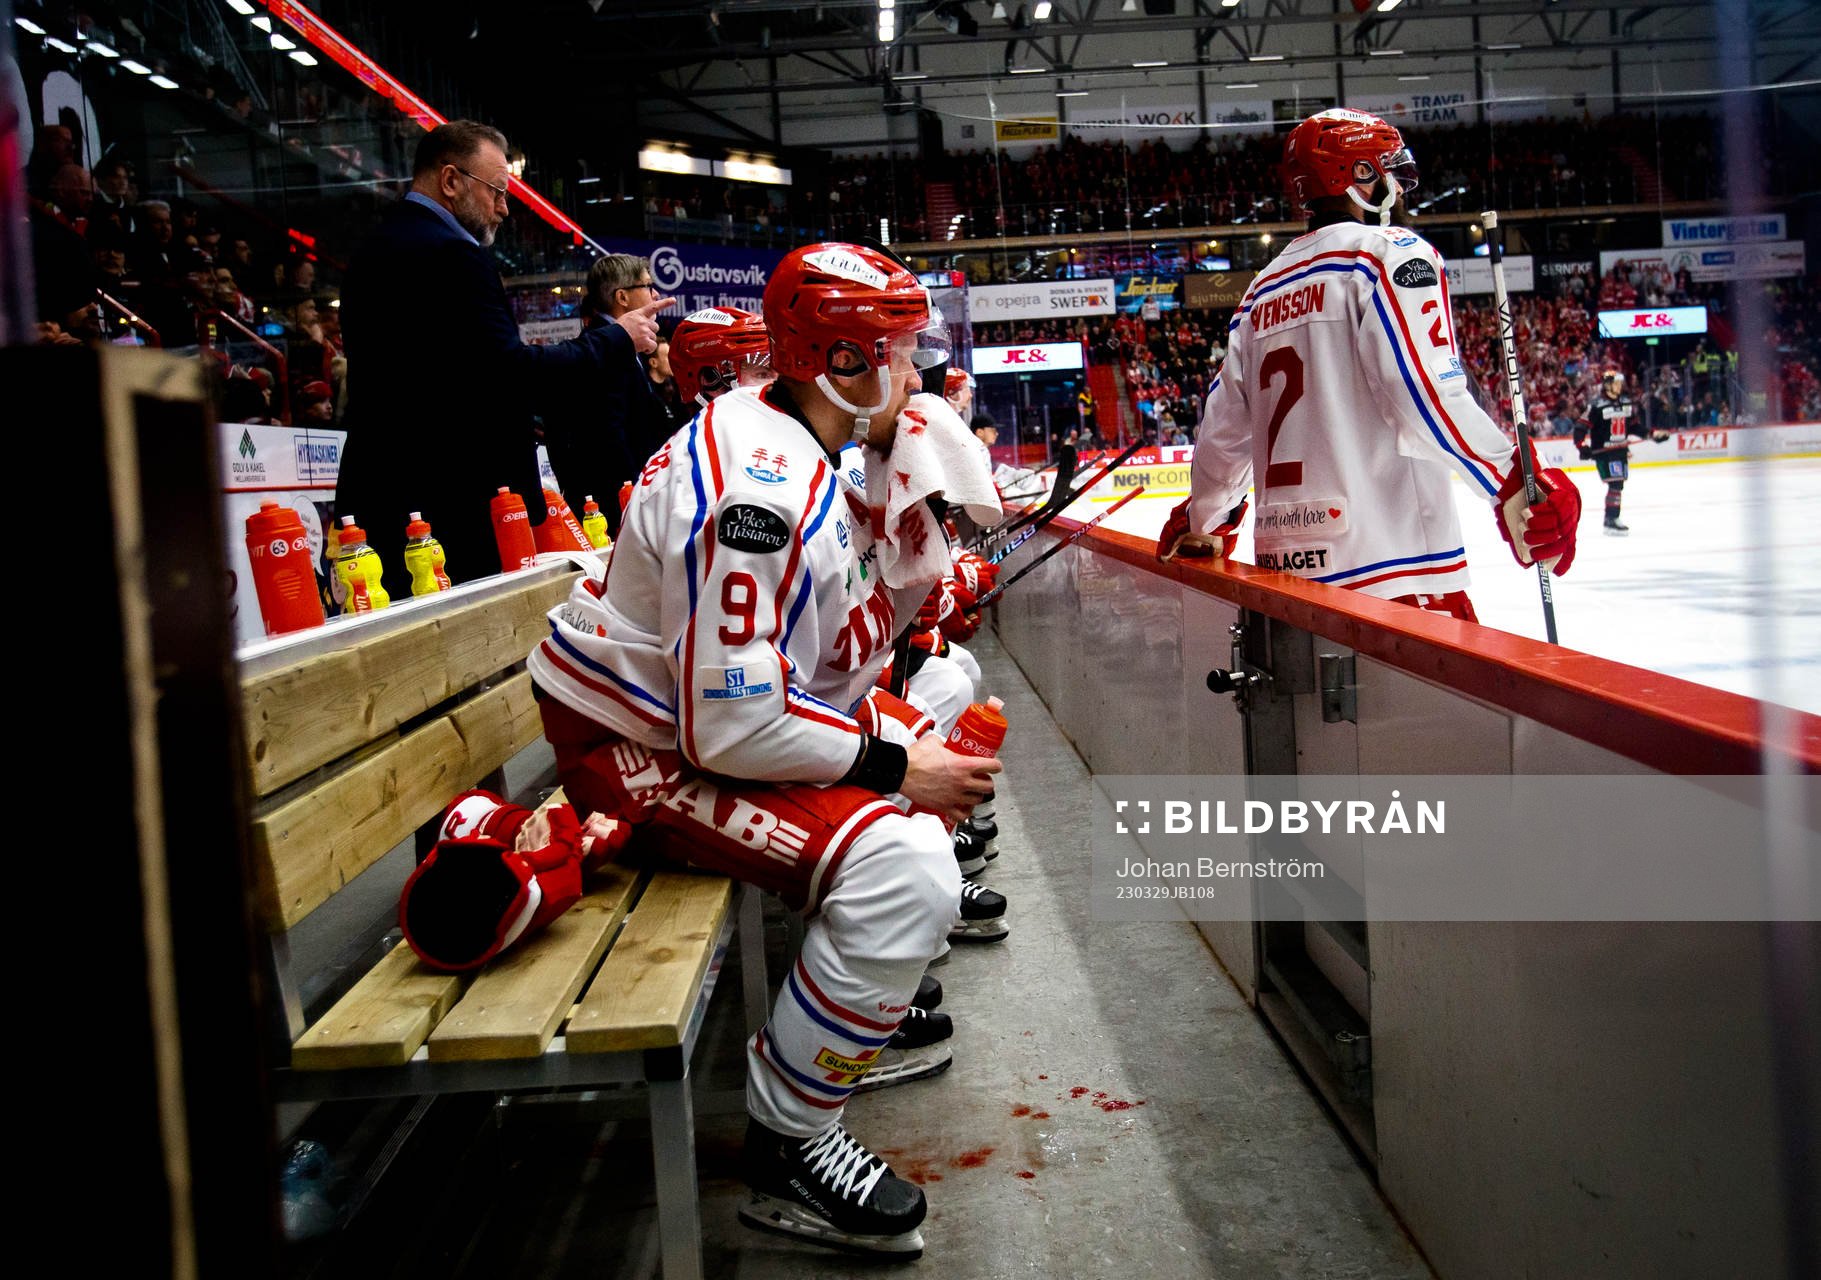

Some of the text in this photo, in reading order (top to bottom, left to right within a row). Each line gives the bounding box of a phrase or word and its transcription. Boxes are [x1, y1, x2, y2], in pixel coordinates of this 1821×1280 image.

[1411, 93, 1465, 109] TRAVEL
[1412, 108, 1458, 123] TEAM
[650, 246, 766, 291] Gustavsvik
[1421, 299, 1449, 348] 2
[1499, 301, 1522, 399] VAPOR
[1260, 346, 1304, 489] 2
[1680, 433, 1725, 449] TAM
[730, 507, 767, 529] Yrkes
[1280, 506, 1301, 529] with
[1303, 505, 1326, 528] love
[722, 523, 784, 547] Mästaren
[272, 541, 286, 555] 63
[718, 571, 757, 647] 9
[727, 669, 743, 687] ST
